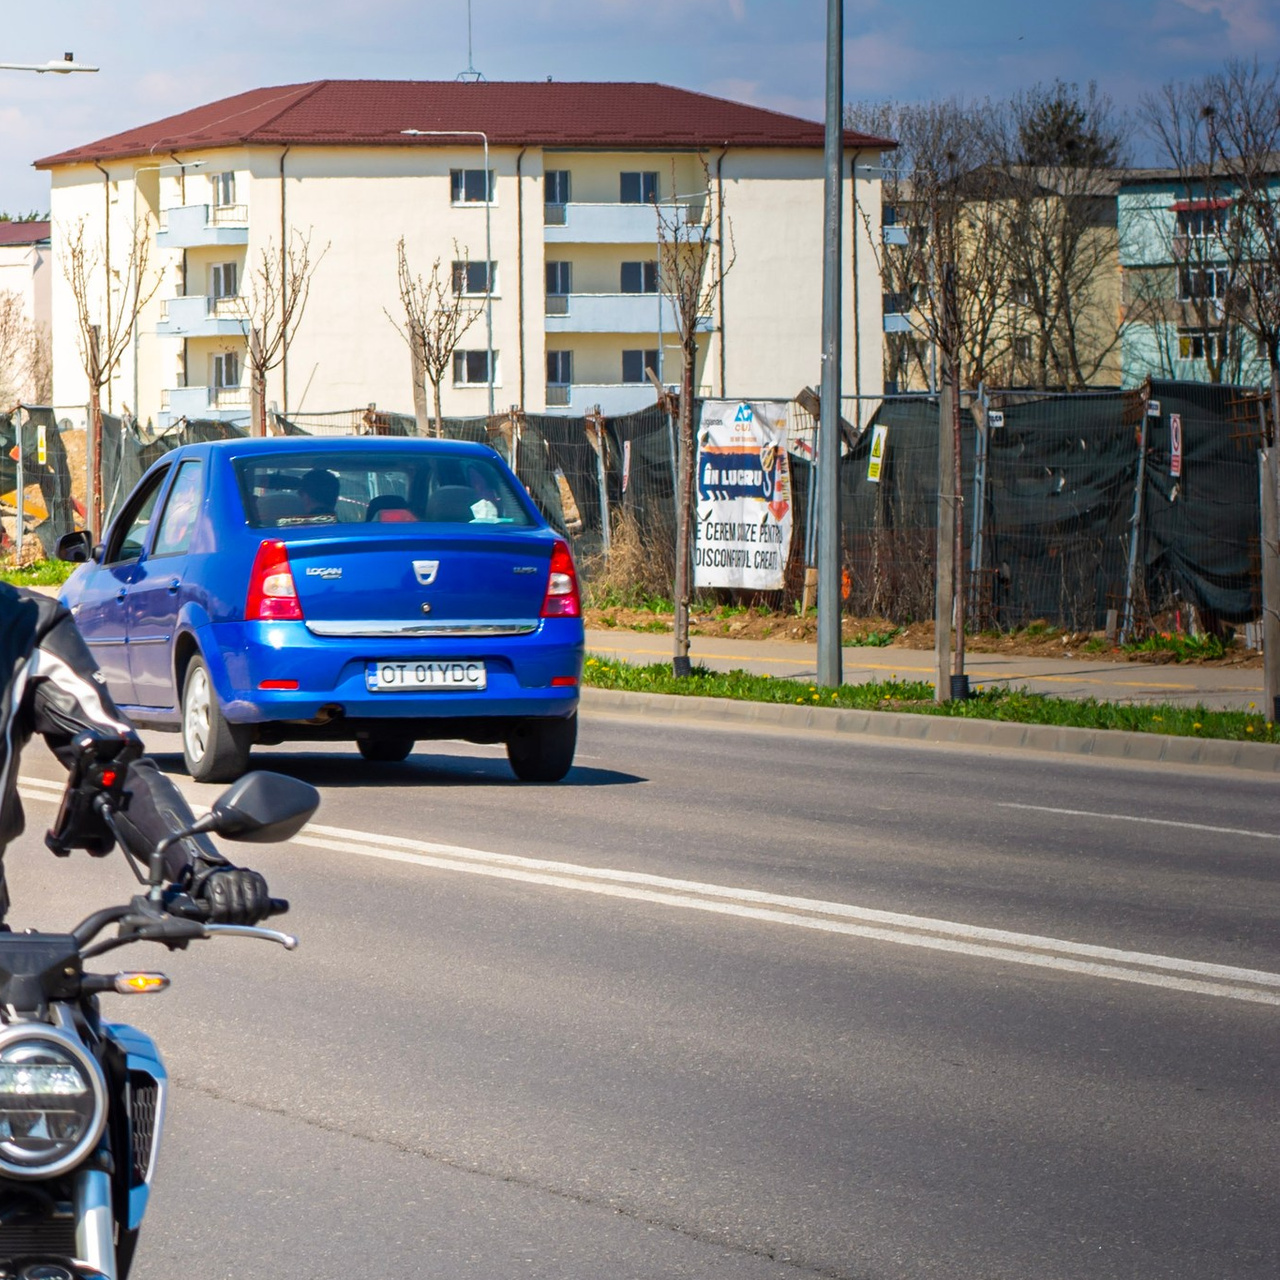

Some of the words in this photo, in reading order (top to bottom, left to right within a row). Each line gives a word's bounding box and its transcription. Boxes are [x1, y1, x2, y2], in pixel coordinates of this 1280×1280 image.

[704, 463, 719, 486] ÎN
[722, 470, 762, 486] LUCRU
[706, 522, 736, 541] CEREM
[306, 567, 342, 576] LOGAN
[382, 665, 407, 683] OT
